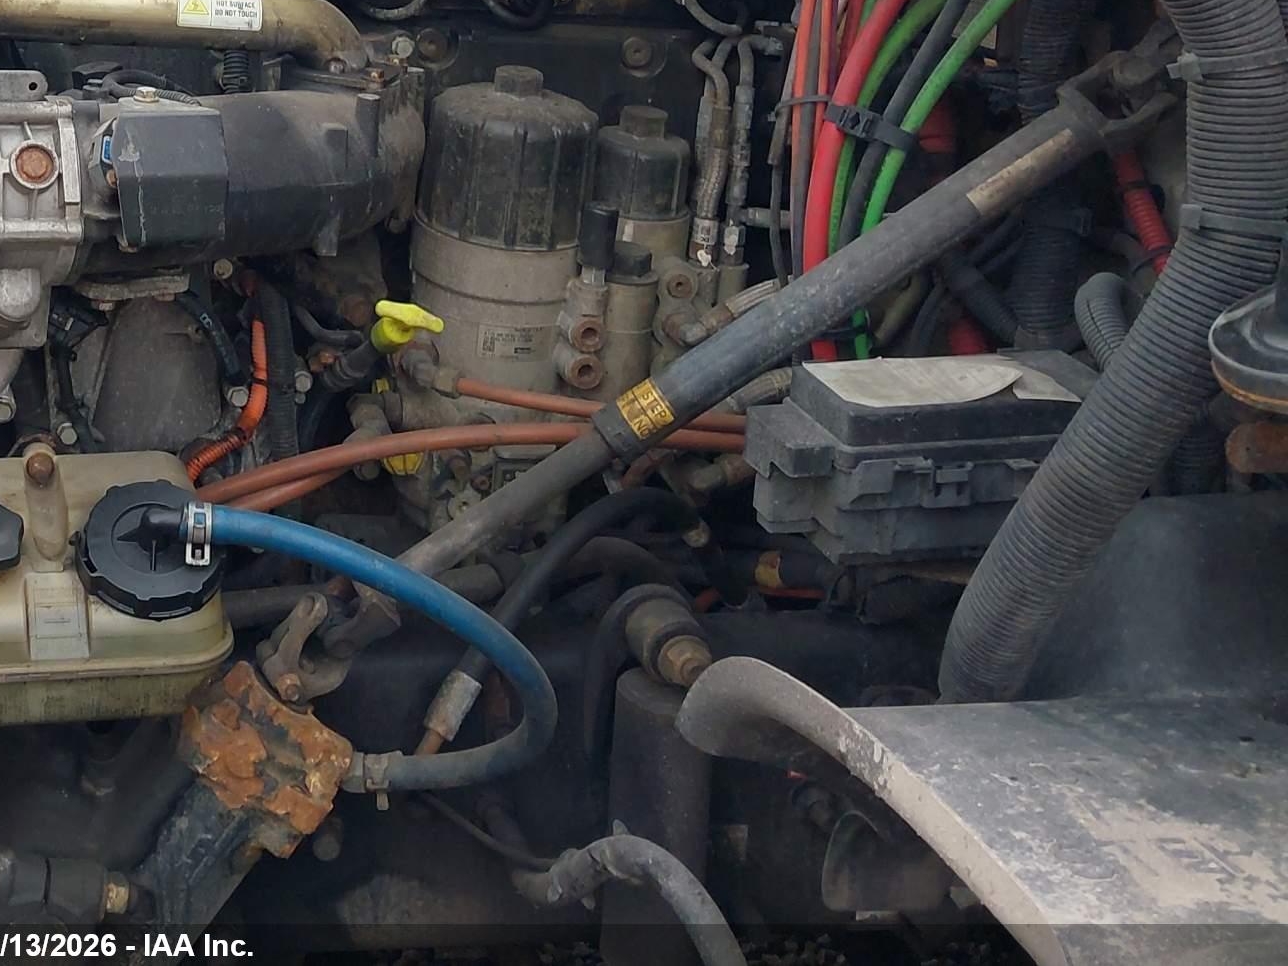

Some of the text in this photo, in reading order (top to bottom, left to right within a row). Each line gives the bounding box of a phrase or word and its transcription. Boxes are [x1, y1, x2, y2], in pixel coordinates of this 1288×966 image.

[215, 0, 229, 8] HOT
[214, 8, 258, 18] DO NOT TOUCH
